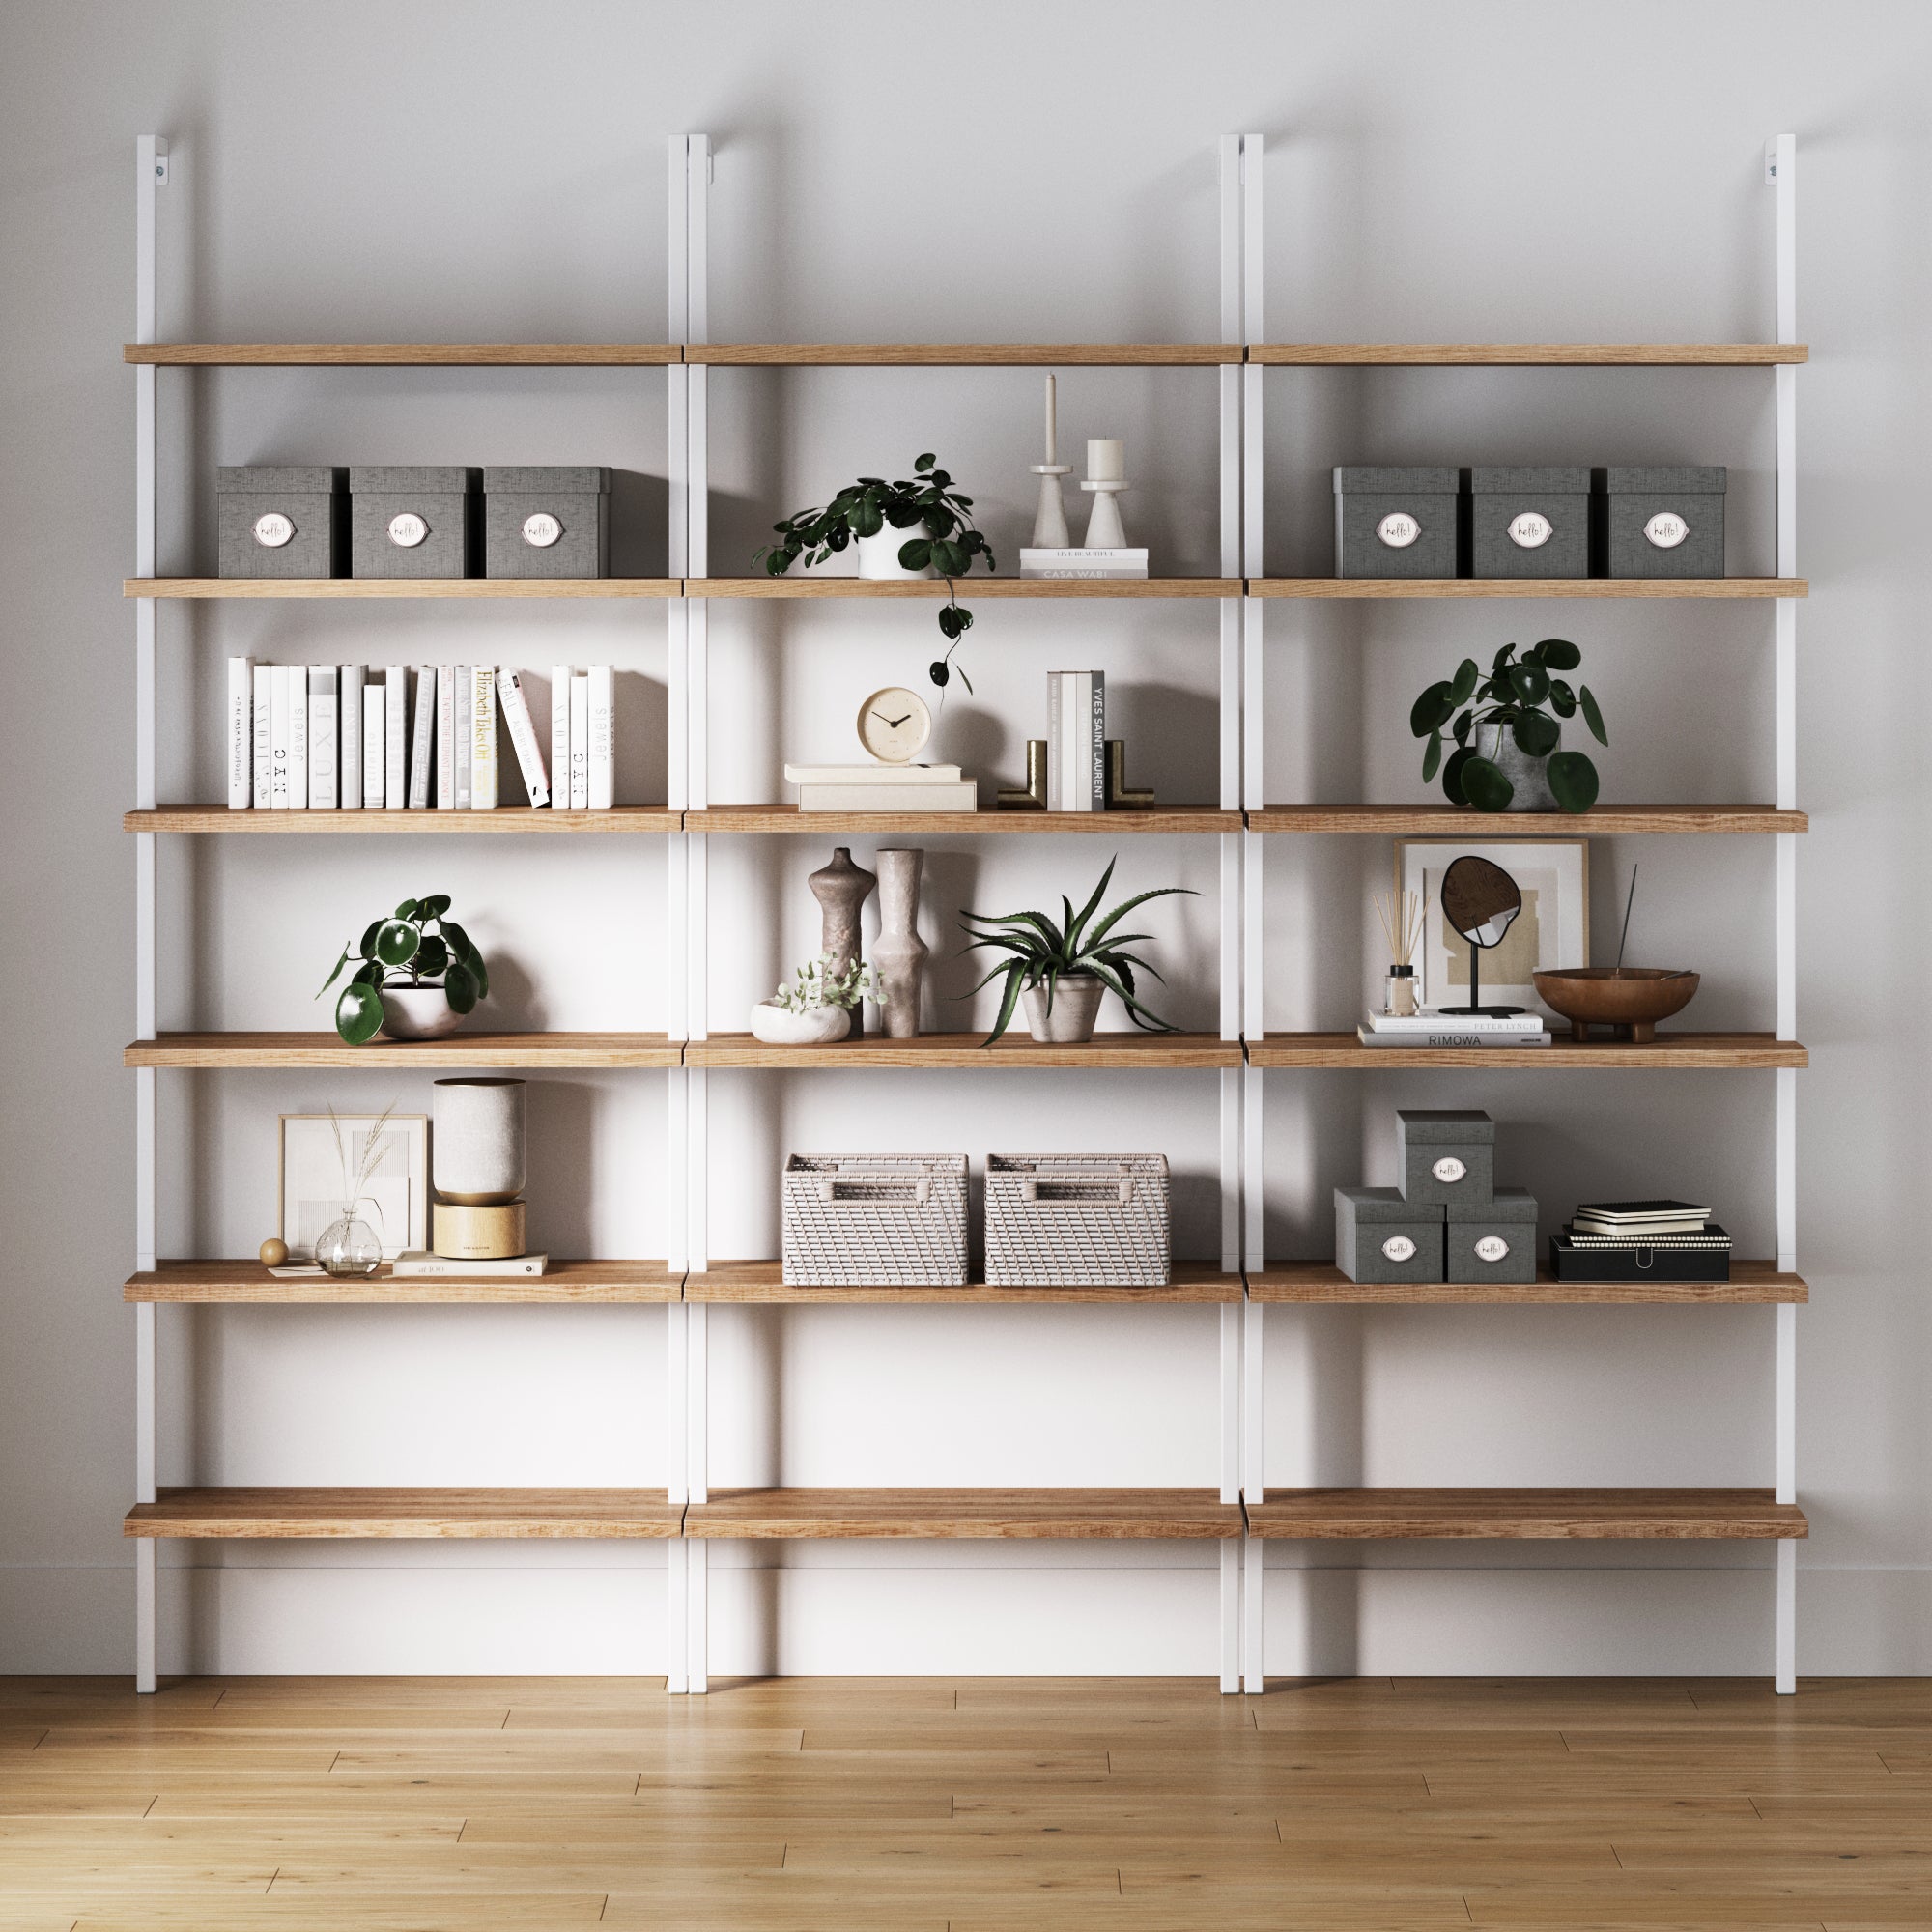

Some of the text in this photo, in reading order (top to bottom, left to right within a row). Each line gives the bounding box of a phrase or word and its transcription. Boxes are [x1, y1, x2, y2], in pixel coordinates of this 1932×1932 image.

[260, 522, 286, 538] hello!
[393, 522, 419, 538] hello!
[527, 522, 554, 538] hello!
[1385, 522, 1411, 539] hello!
[1517, 522, 1544, 539] hello!
[1653, 522, 1680, 539] hello!
[1043, 570, 1107, 579] CASA WABI
[476, 671, 493, 716] Elizabeth
[292, 707, 304, 762] Jewels
[346, 704, 356, 771] MILANO
[476, 717, 492, 743] Takes
[595, 706, 609, 762] Jewels
[474, 744, 491, 760] Off
[1094, 687, 1103, 800] YVES SAINT LAURENT
[315, 703, 332, 803] LUXE
[274, 748, 286, 794] NYC
[1506, 1022, 1537, 1031] LYNCH
[1429, 1036, 1482, 1046] RIMOWA
[1438, 1164, 1459, 1178] hello!
[1388, 1242, 1409, 1256] hello!
[1482, 1242, 1502, 1256] hello!
